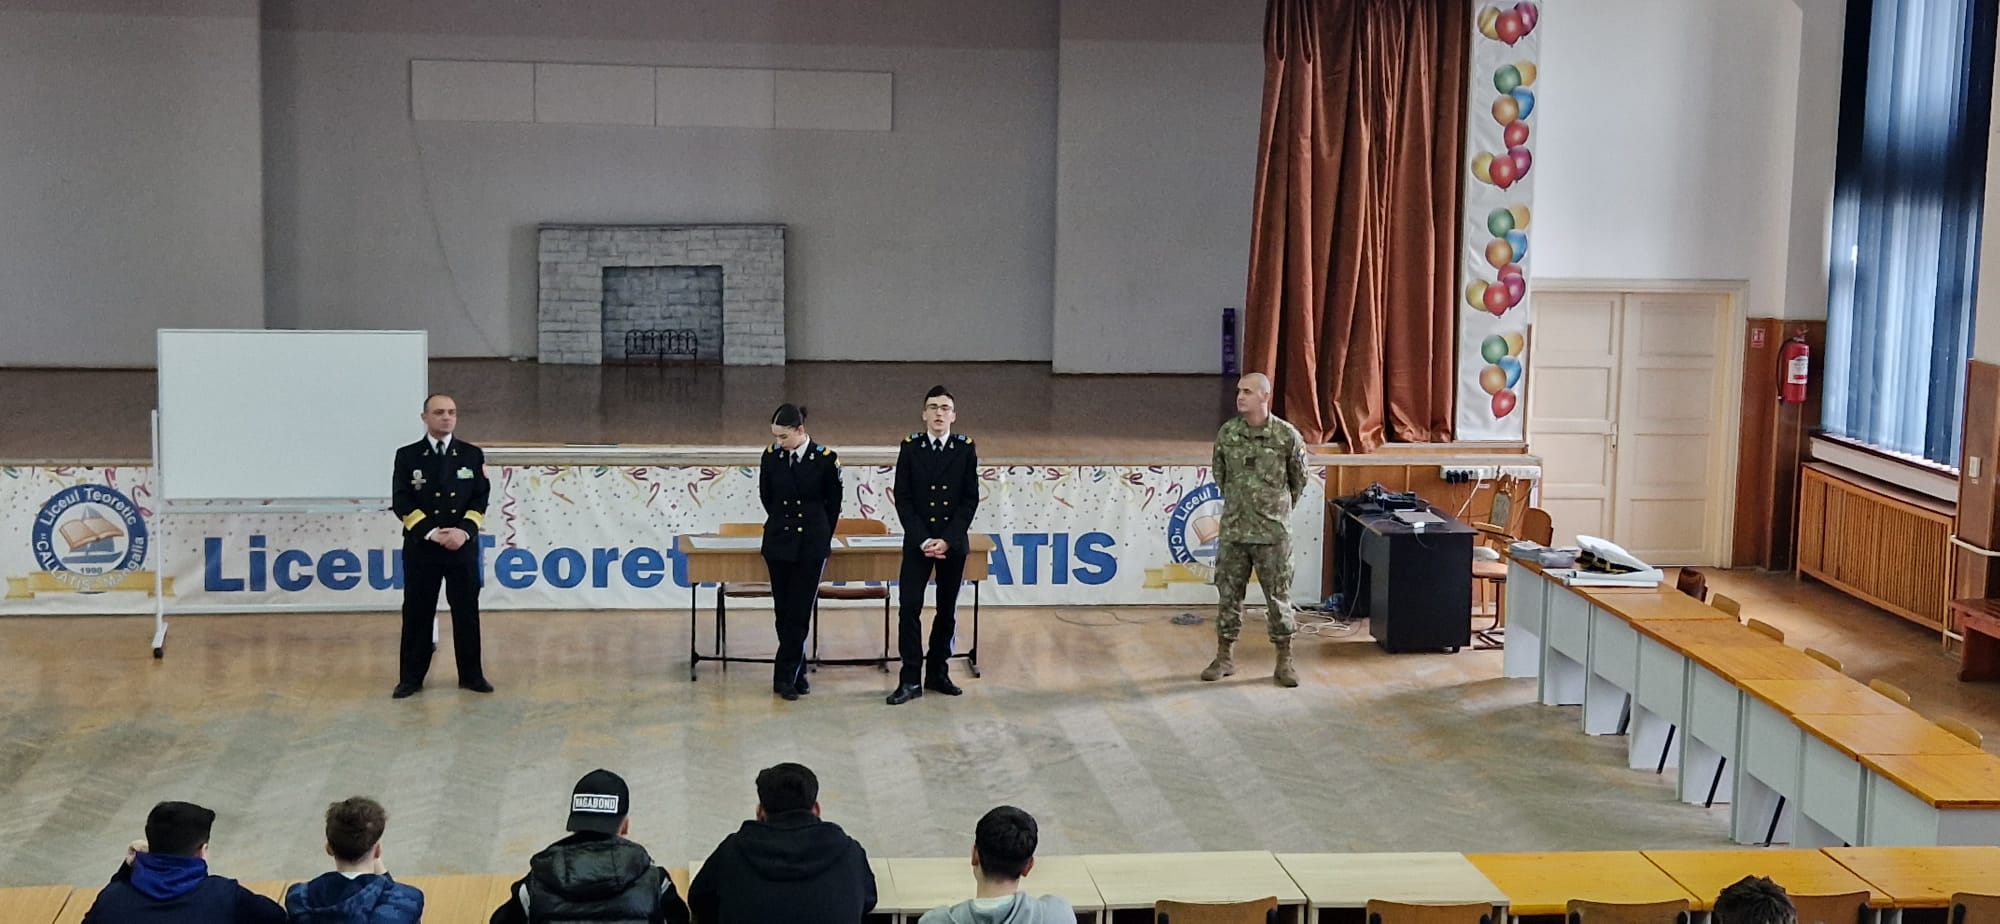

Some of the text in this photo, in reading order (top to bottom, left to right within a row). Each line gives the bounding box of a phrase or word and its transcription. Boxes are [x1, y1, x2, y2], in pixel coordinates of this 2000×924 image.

[40, 488, 137, 526] Liceul Teoretic
[1175, 488, 1211, 521] Liceul
[203, 534, 404, 592] Liceu
[478, 533, 717, 590] eoret
[575, 797, 616, 809] VAGABOND
